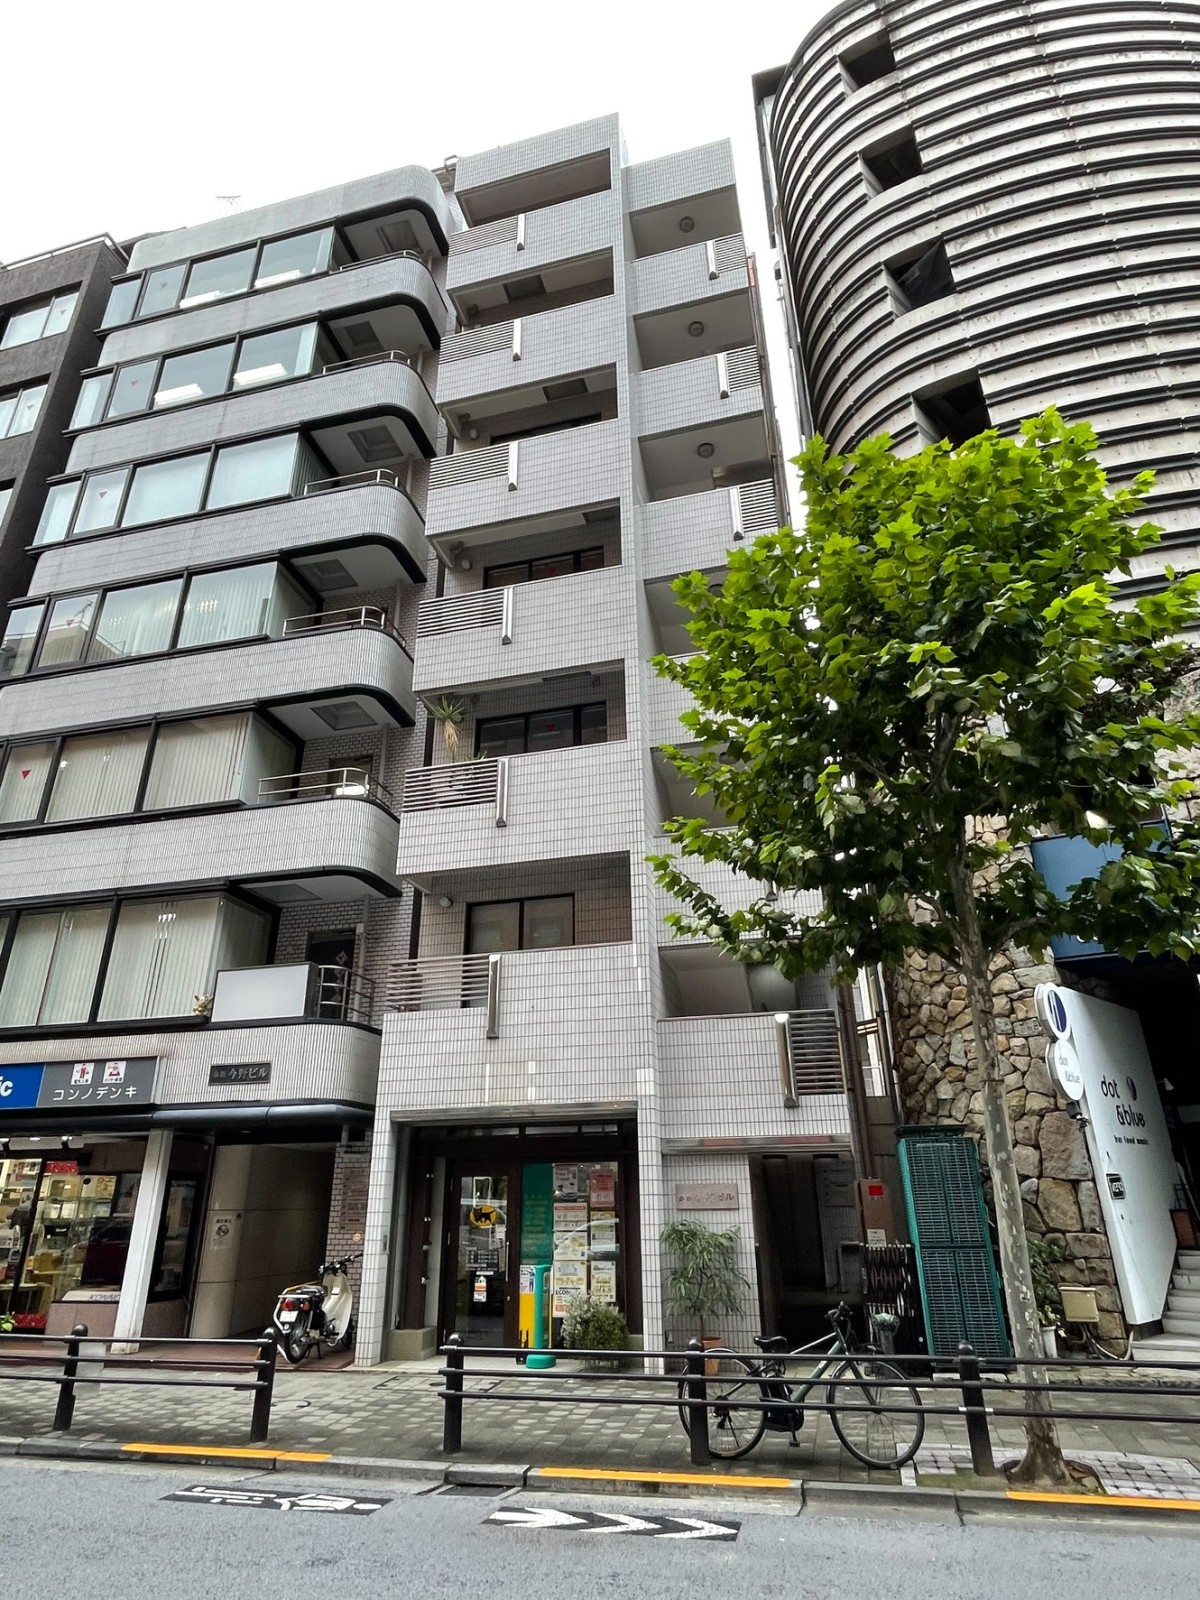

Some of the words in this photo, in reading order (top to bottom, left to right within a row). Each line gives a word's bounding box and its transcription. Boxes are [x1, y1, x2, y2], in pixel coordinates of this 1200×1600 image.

[53, 1086, 137, 1101] コンノデンキ
[1100, 1075, 1120, 1098] dot
[1116, 1103, 1145, 1127] &blue
